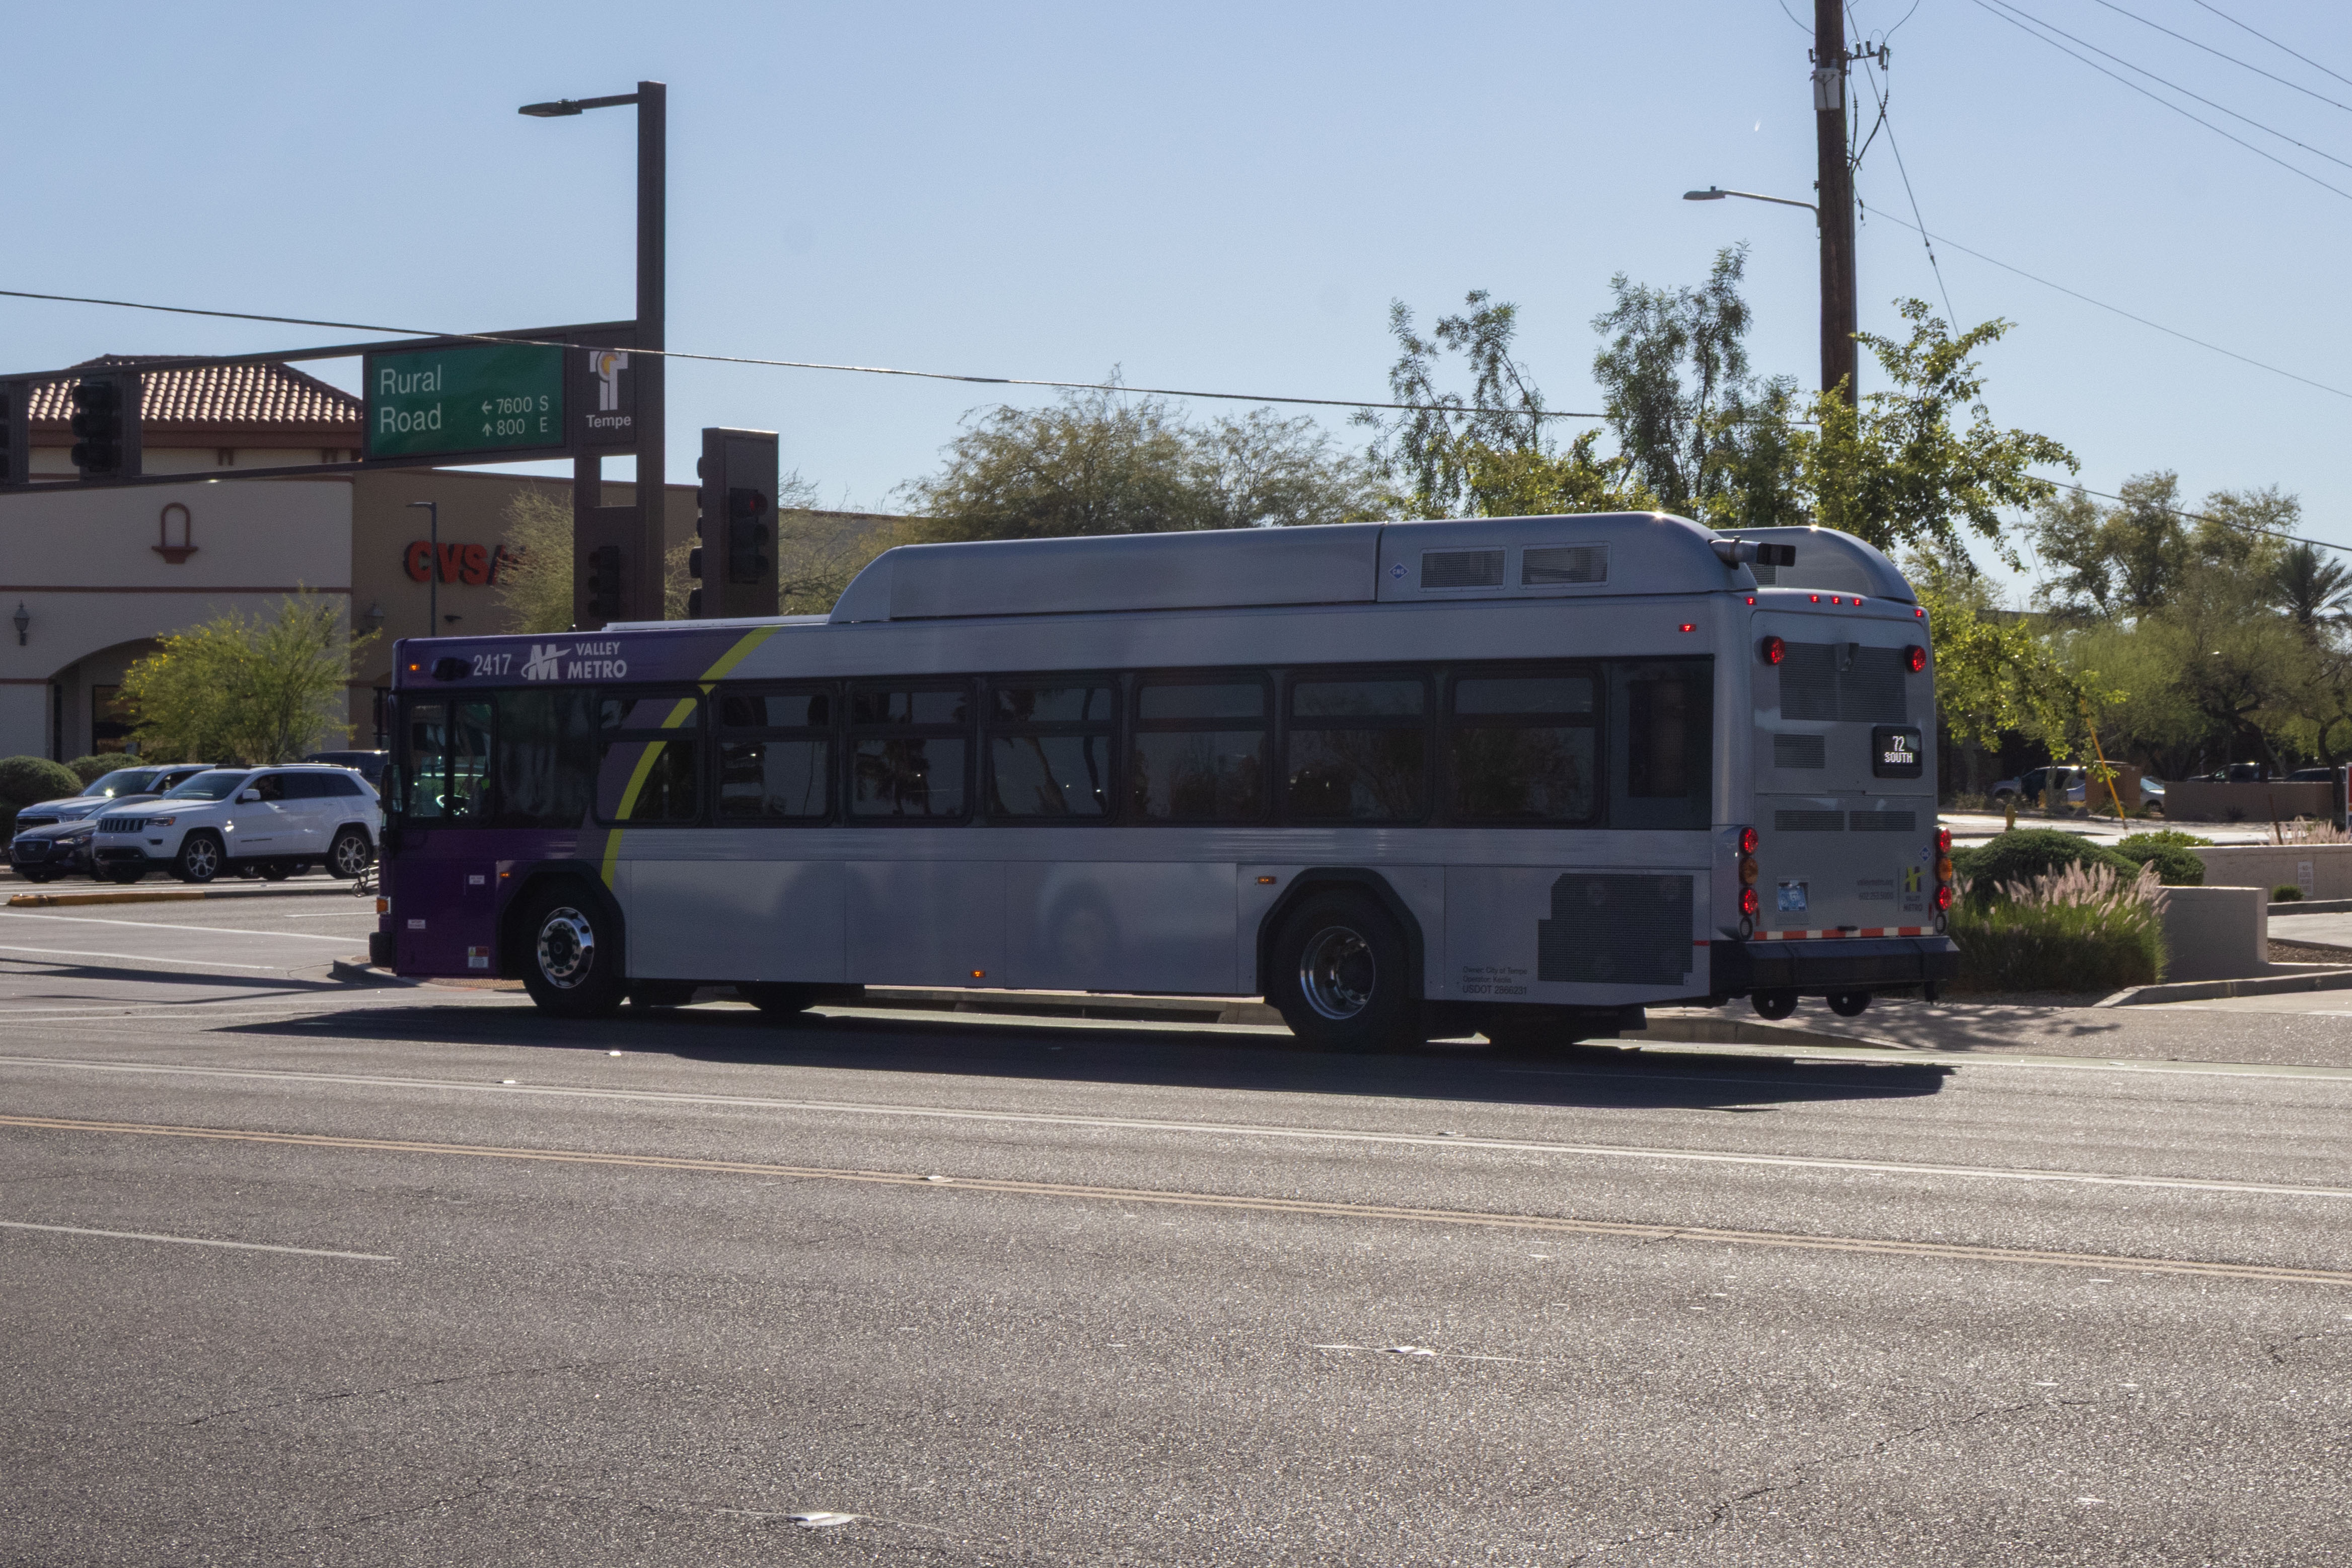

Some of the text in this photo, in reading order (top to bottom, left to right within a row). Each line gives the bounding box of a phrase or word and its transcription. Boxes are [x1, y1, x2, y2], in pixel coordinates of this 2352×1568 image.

[380, 364, 441, 395] Rural
[496, 395, 549, 414] 7600 S
[380, 402, 441, 433] Road
[497, 417, 548, 435] 800 E
[585, 414, 632, 429] Tempe
[575, 642, 621, 656] VALLEY
[473, 654, 512, 676] 2417
[567, 660, 627, 679] METRO
[1892, 736, 1905, 752] 72
[1884, 752, 1913, 763] SOUTH
[1486, 966, 1498, 975] City
[1507, 967, 1528, 975] Tempe
[1462, 984, 1492, 994] USDOT
